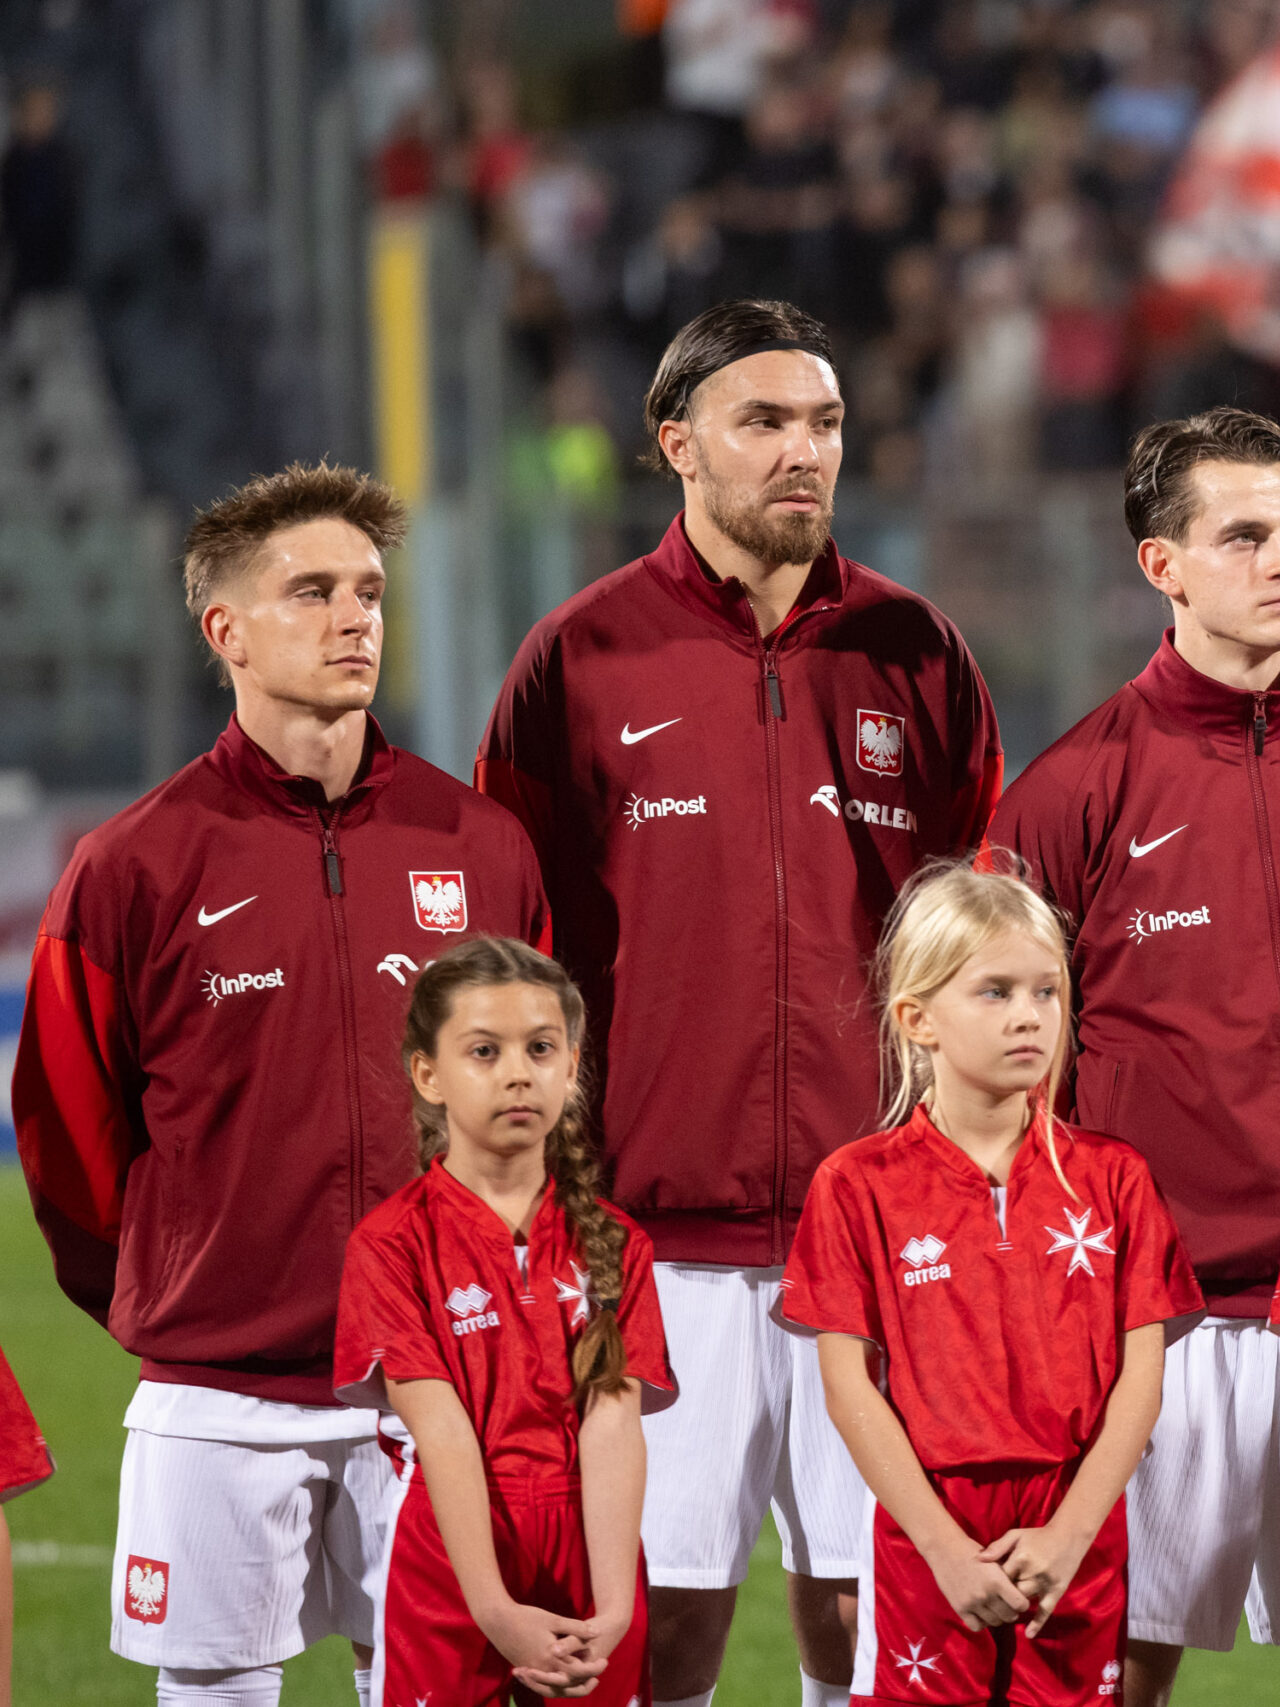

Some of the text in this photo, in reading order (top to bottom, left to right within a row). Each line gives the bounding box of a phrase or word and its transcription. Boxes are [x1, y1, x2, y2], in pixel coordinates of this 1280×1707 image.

[643, 795, 707, 818] InPost
[845, 799, 918, 834] ORLEN
[1148, 905, 1212, 932] InPost
[220, 968, 285, 996] InPost
[903, 1263, 951, 1286] errea
[452, 1311, 500, 1336] errea
